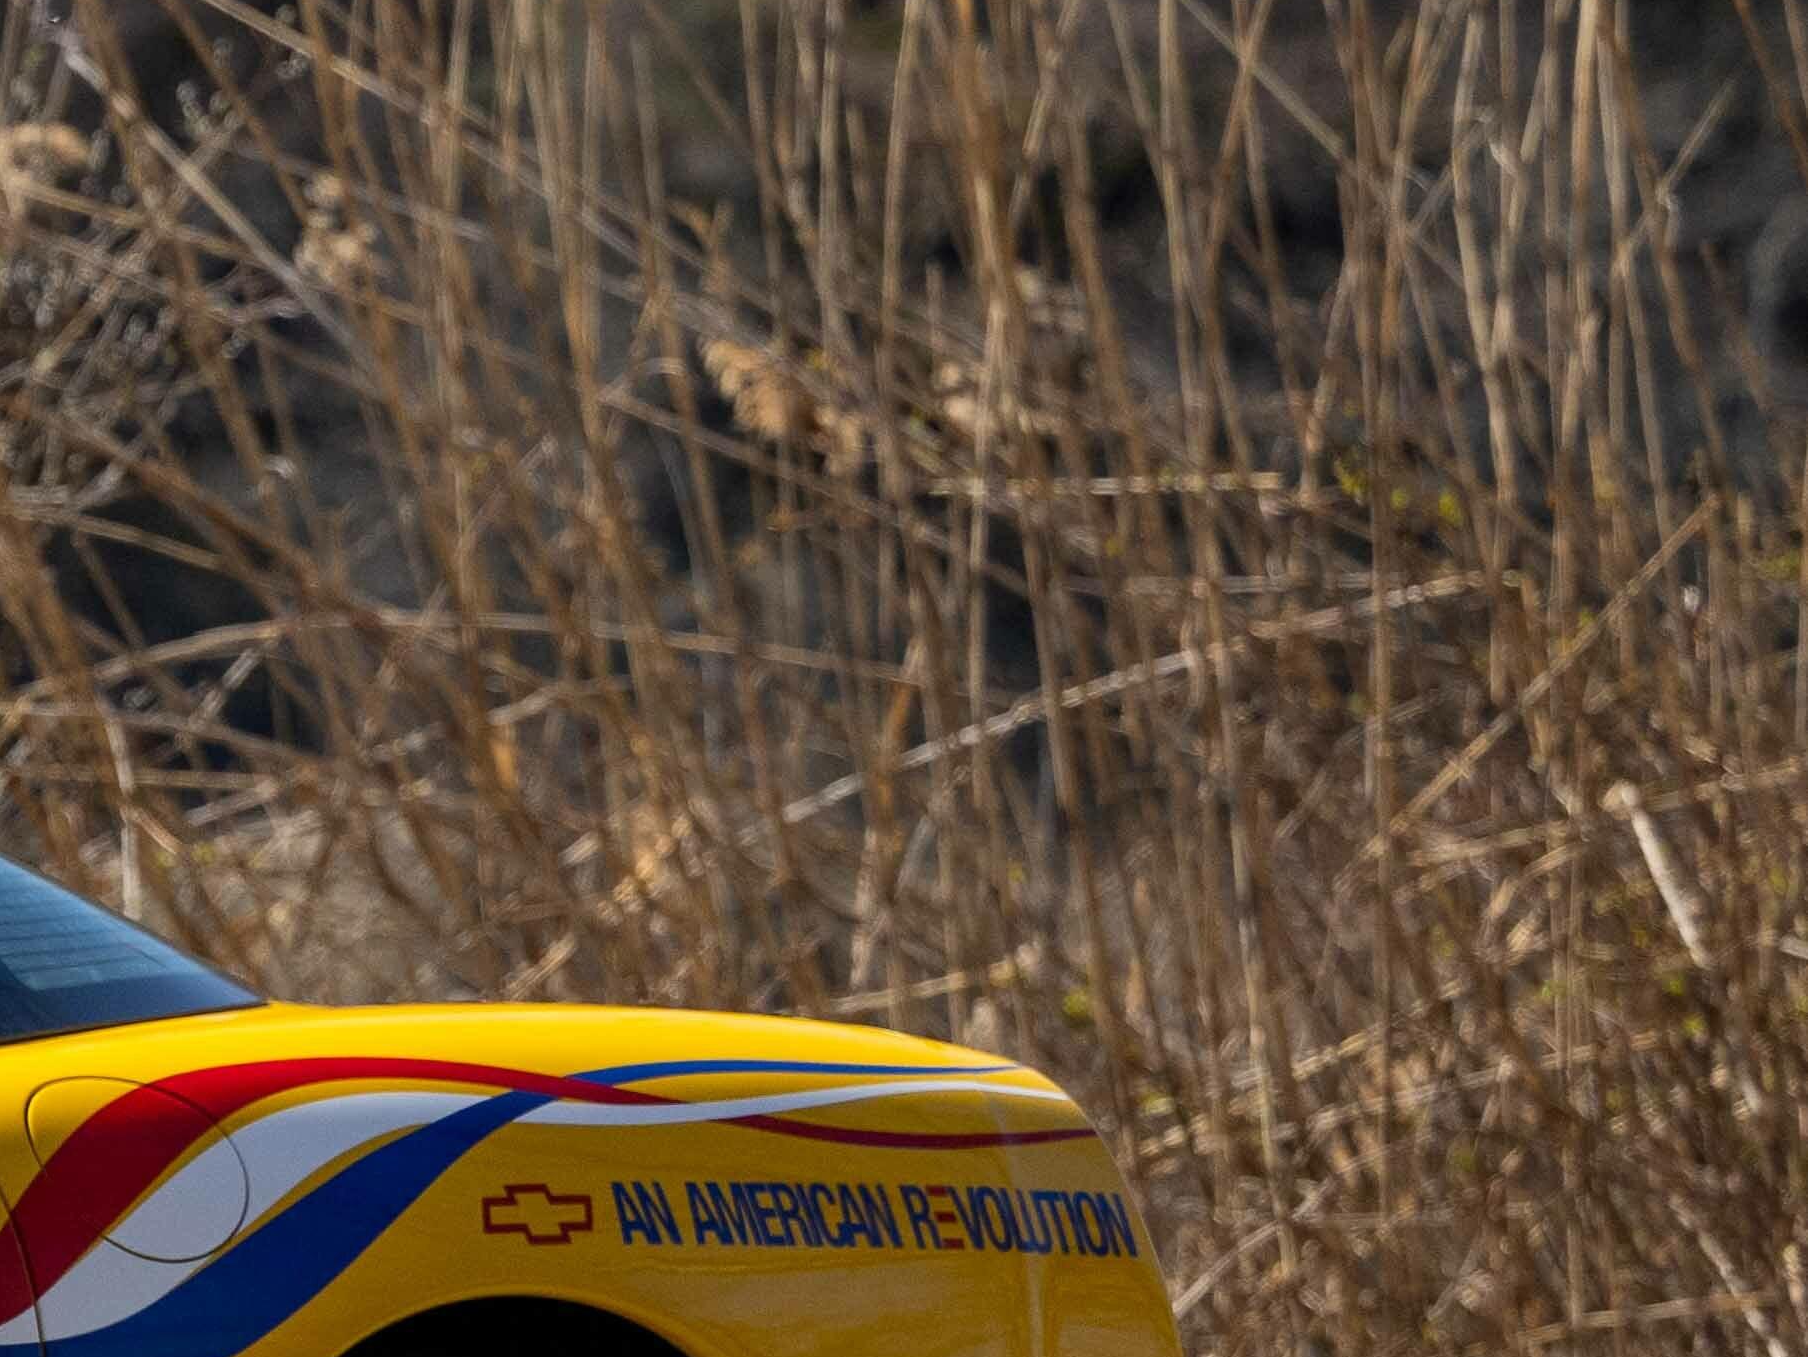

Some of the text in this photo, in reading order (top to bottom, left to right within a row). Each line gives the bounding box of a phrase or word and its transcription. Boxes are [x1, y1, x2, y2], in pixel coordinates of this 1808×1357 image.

[610, 1180, 1140, 1258] AN AMERICAN REVOLUTION
